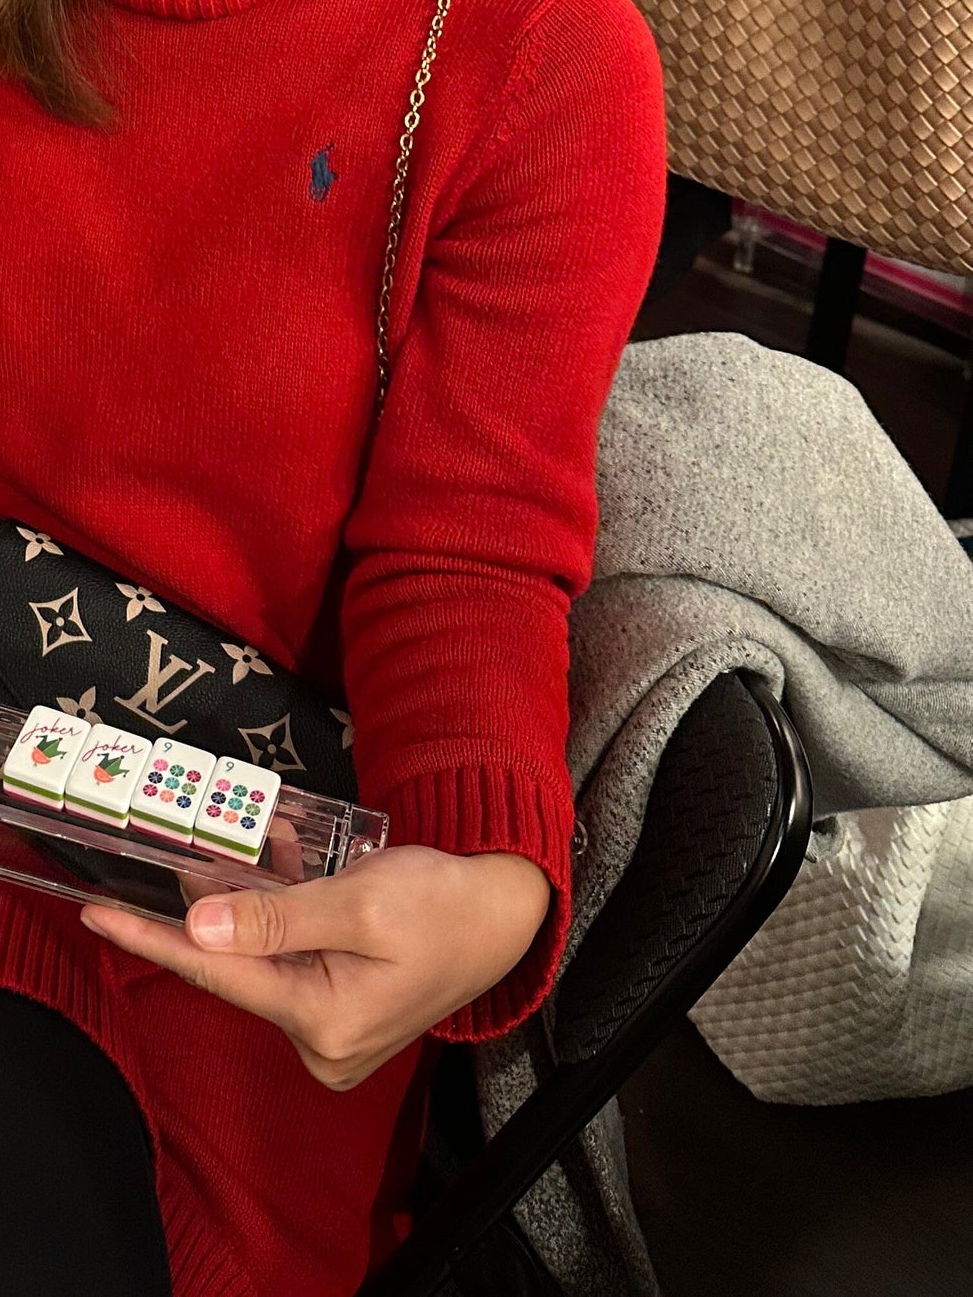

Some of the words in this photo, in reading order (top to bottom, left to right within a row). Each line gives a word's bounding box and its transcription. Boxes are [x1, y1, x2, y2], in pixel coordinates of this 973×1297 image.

[20, 717, 83, 744] joker
[81, 735, 144, 762] joker
[164, 742, 173, 753] 9
[226, 761, 235, 773] 9
